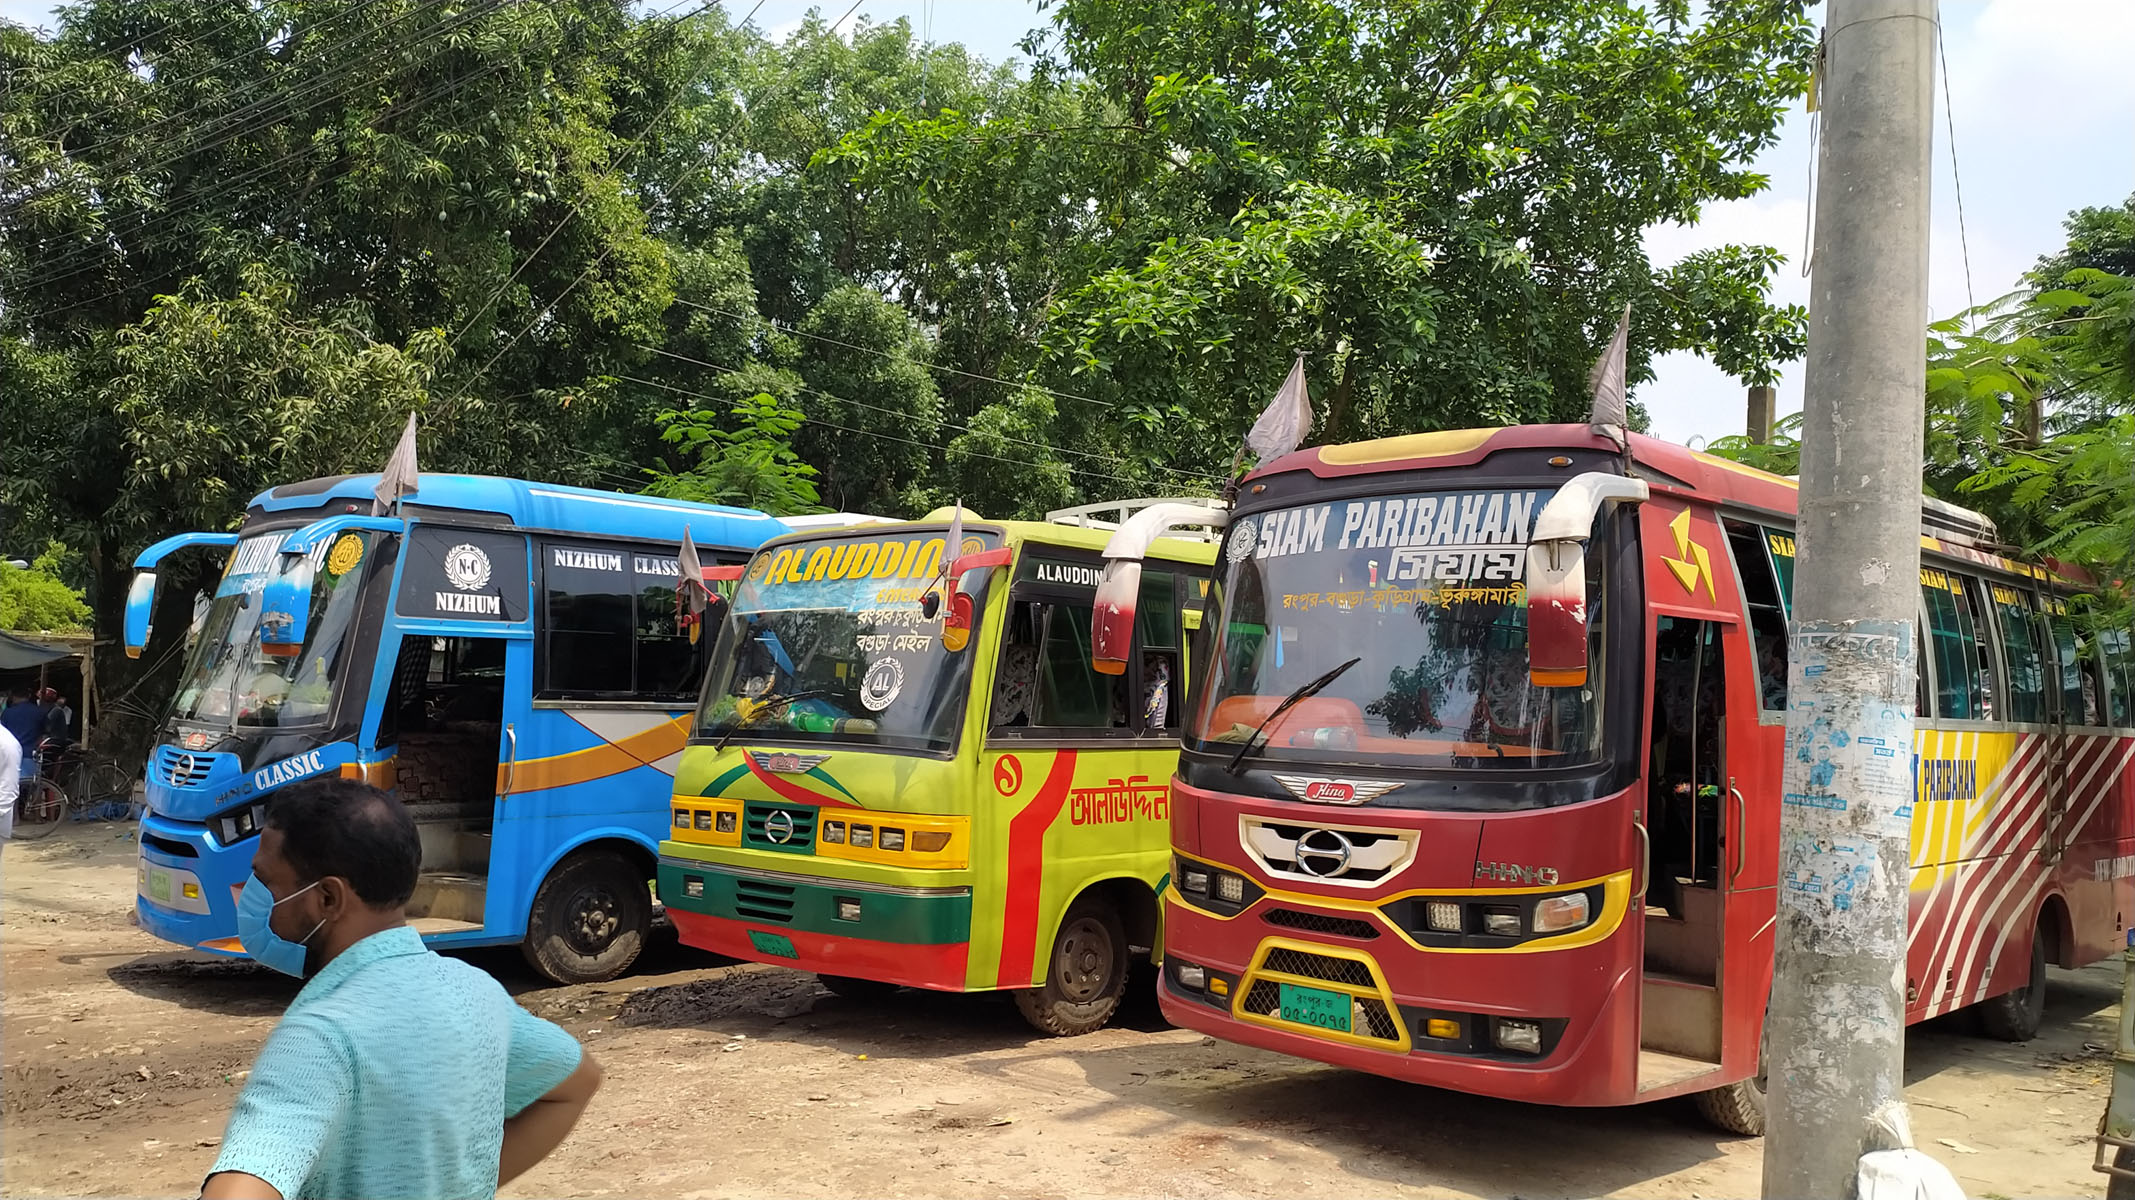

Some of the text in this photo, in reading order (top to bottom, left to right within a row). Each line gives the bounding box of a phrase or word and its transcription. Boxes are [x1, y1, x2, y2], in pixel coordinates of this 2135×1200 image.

[1256, 492, 1537, 560] SIAM PARIBAHAN
[554, 550, 682, 577] NIZHUM CLASS
[764, 538, 947, 585] ALAUDDIN
[1037, 563, 1103, 586] ALAUDDIN
[435, 592, 501, 615] NIZHUM
[870, 672, 891, 691] AL
[863, 694, 894, 709] SPECIAL
[254, 750, 325, 791] CLASSIC
[1923, 759, 1977, 802] PARIBAHAN
[1312, 783, 1346, 799] Hino
[1476, 860, 1559, 886] HINO
